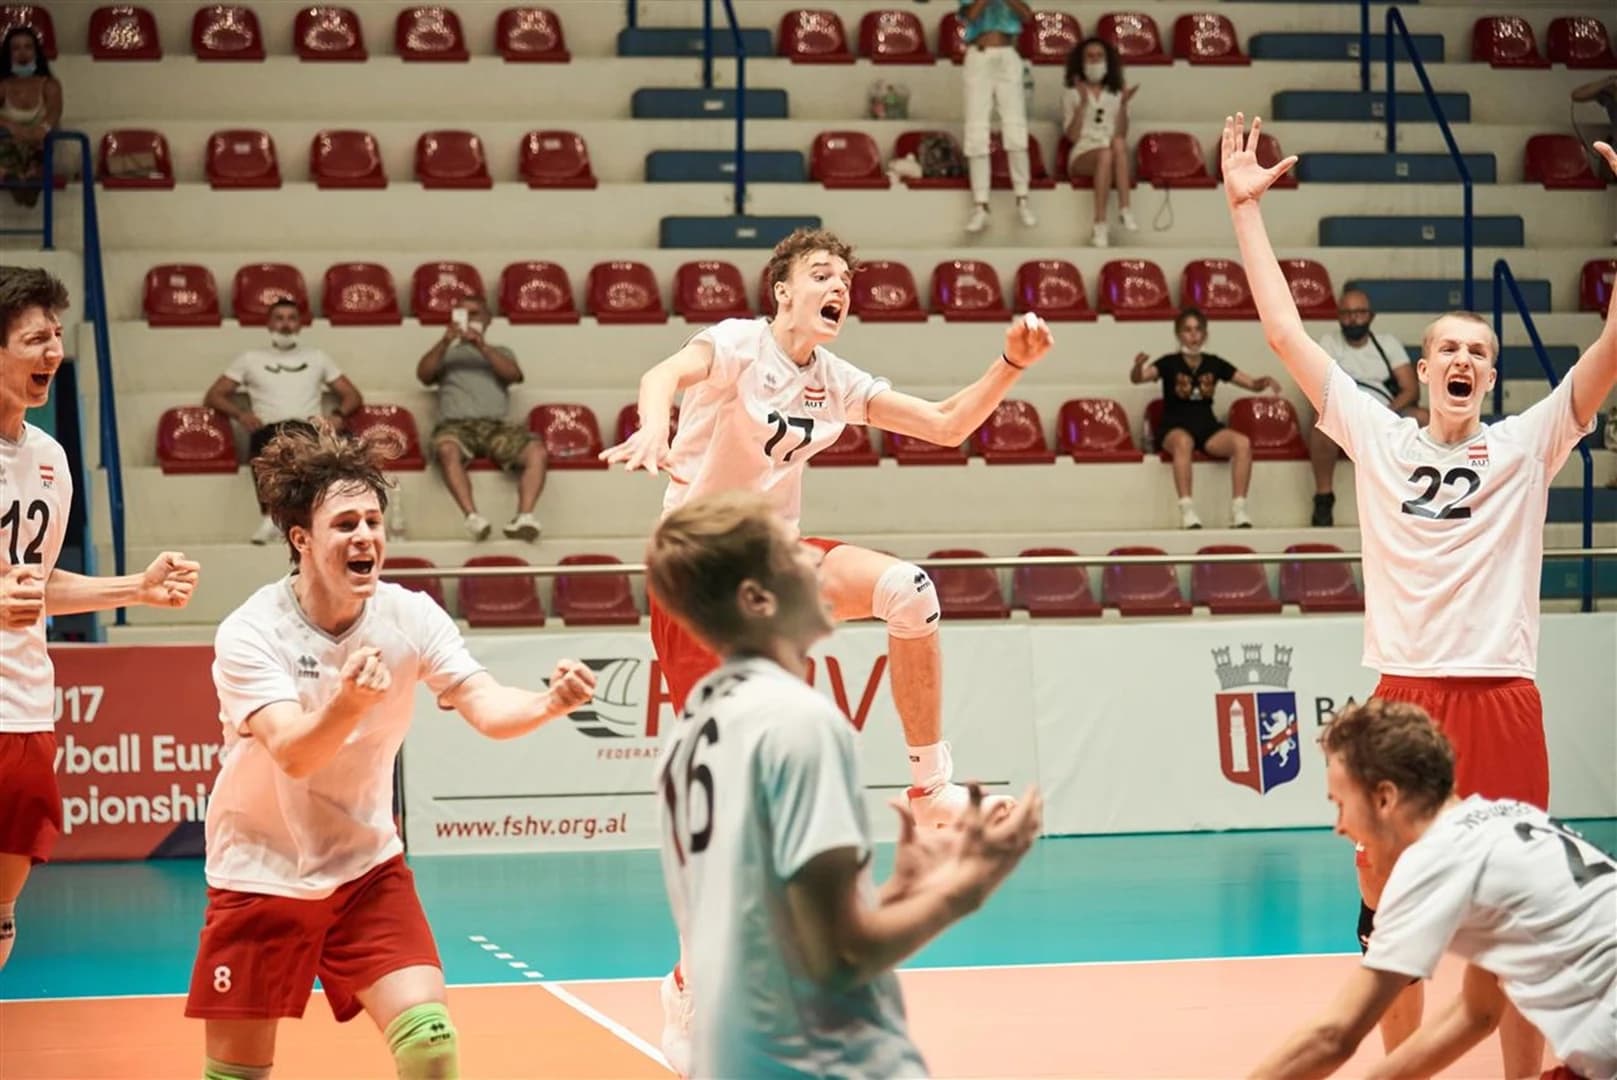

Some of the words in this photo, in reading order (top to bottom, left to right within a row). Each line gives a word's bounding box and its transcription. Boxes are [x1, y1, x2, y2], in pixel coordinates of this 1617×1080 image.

[804, 400, 824, 408] AUT
[1402, 466, 1480, 519] 22
[0, 500, 49, 565] 12
[660, 717, 719, 867] 16
[436, 812, 627, 840] www.fshv.org.al
[213, 965, 232, 993] 8
